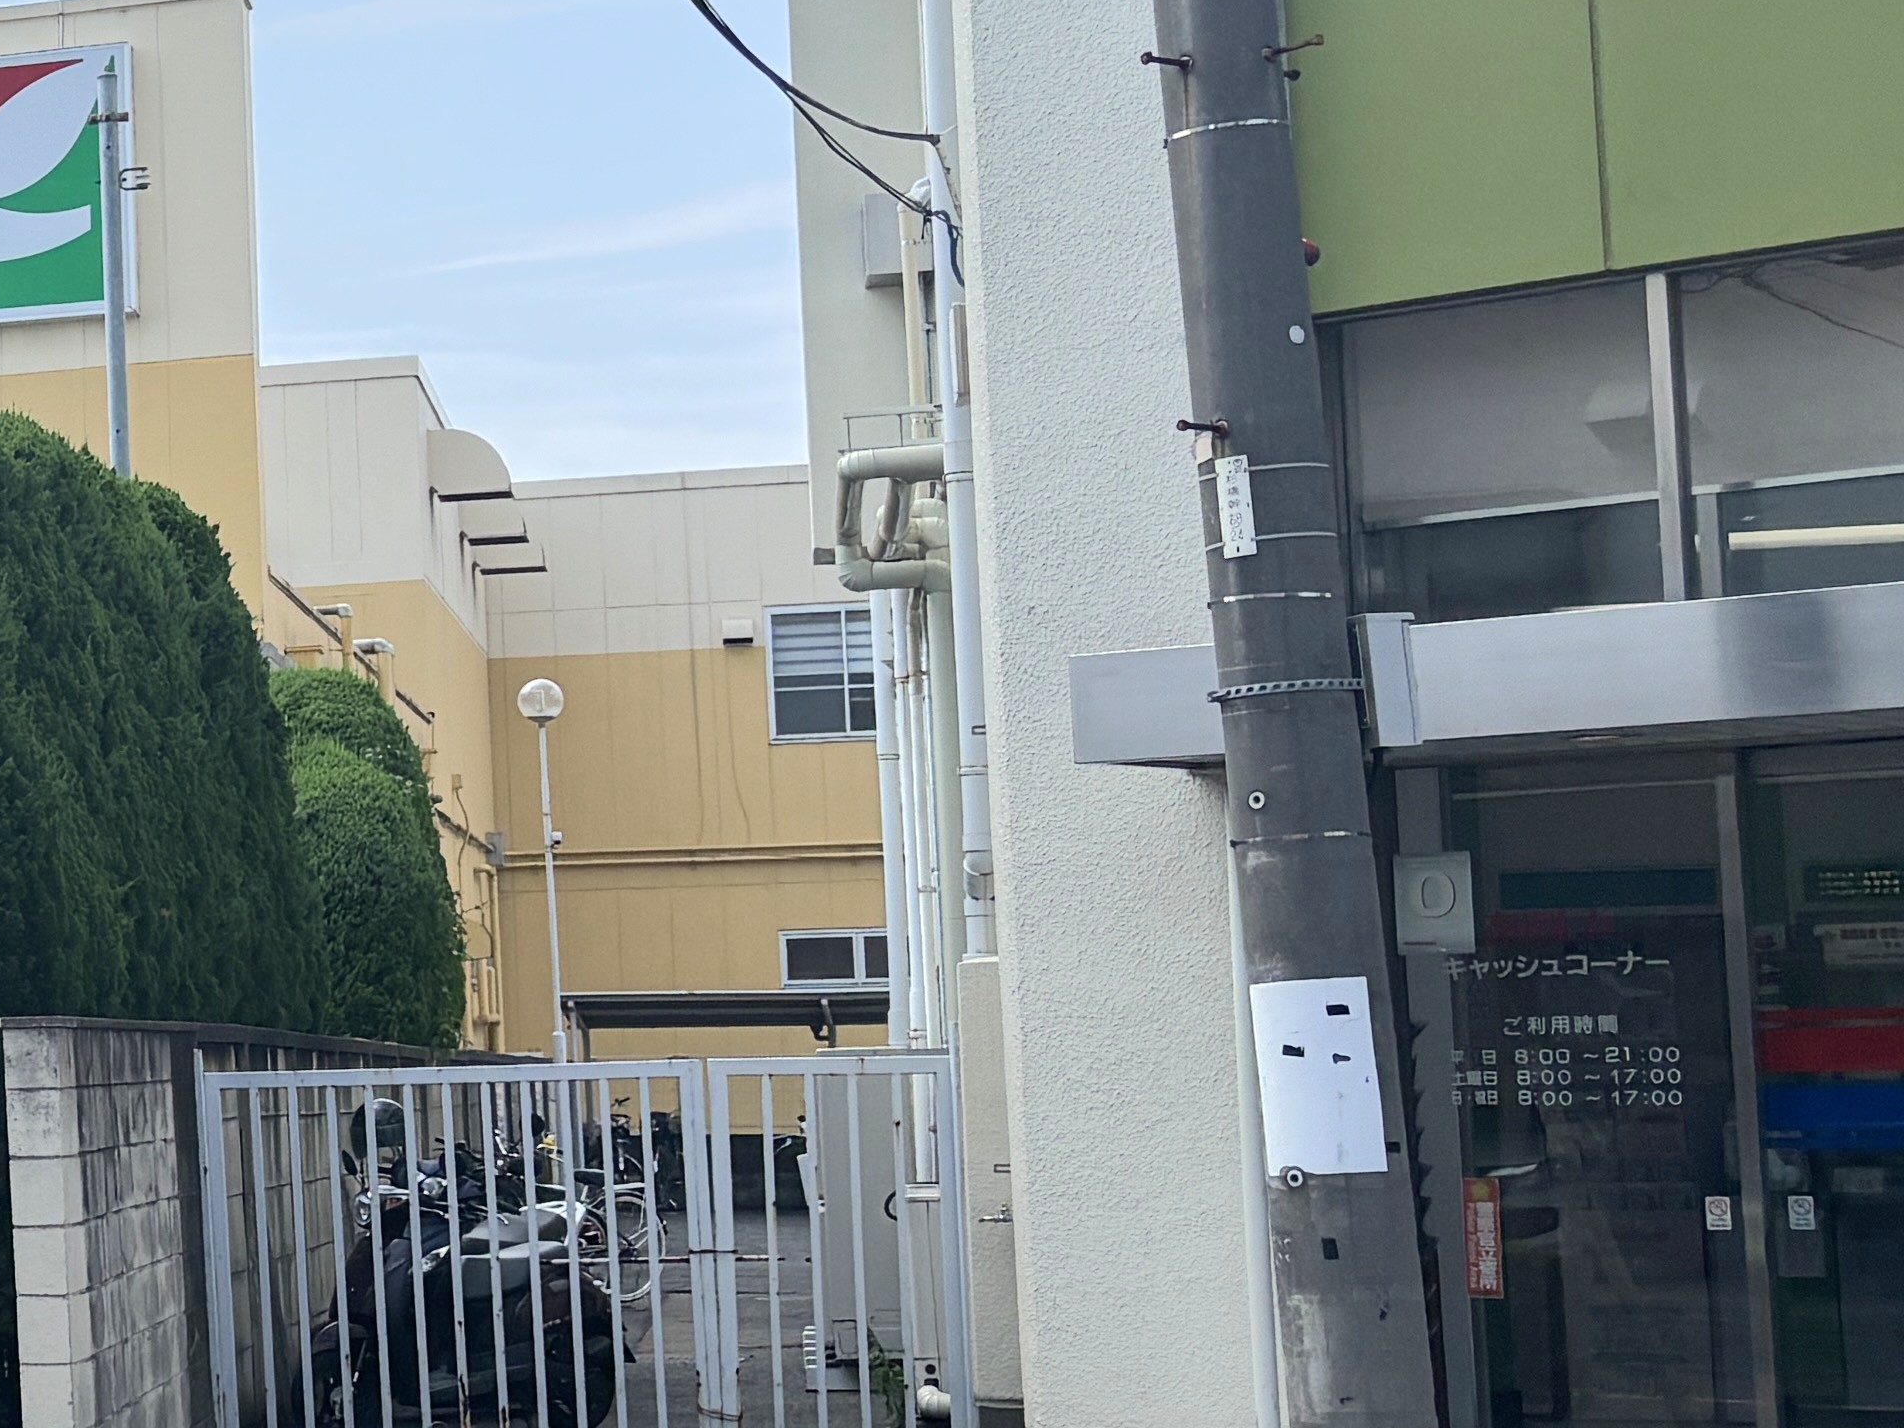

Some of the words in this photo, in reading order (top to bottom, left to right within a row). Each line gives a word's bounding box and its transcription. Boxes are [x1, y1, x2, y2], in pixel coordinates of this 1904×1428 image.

[1445, 950, 1670, 980] キャッシュコーナー
[1515, 1048, 1571, 1065] 8:00
[1605, 1046, 1681, 1063] 21:00
[1517, 1069, 1572, 1086] 8:00
[1610, 1068, 1682, 1085] 17:00
[1518, 1089, 1573, 1106] 8:00
[1611, 1090, 1683, 1106] 17:00
